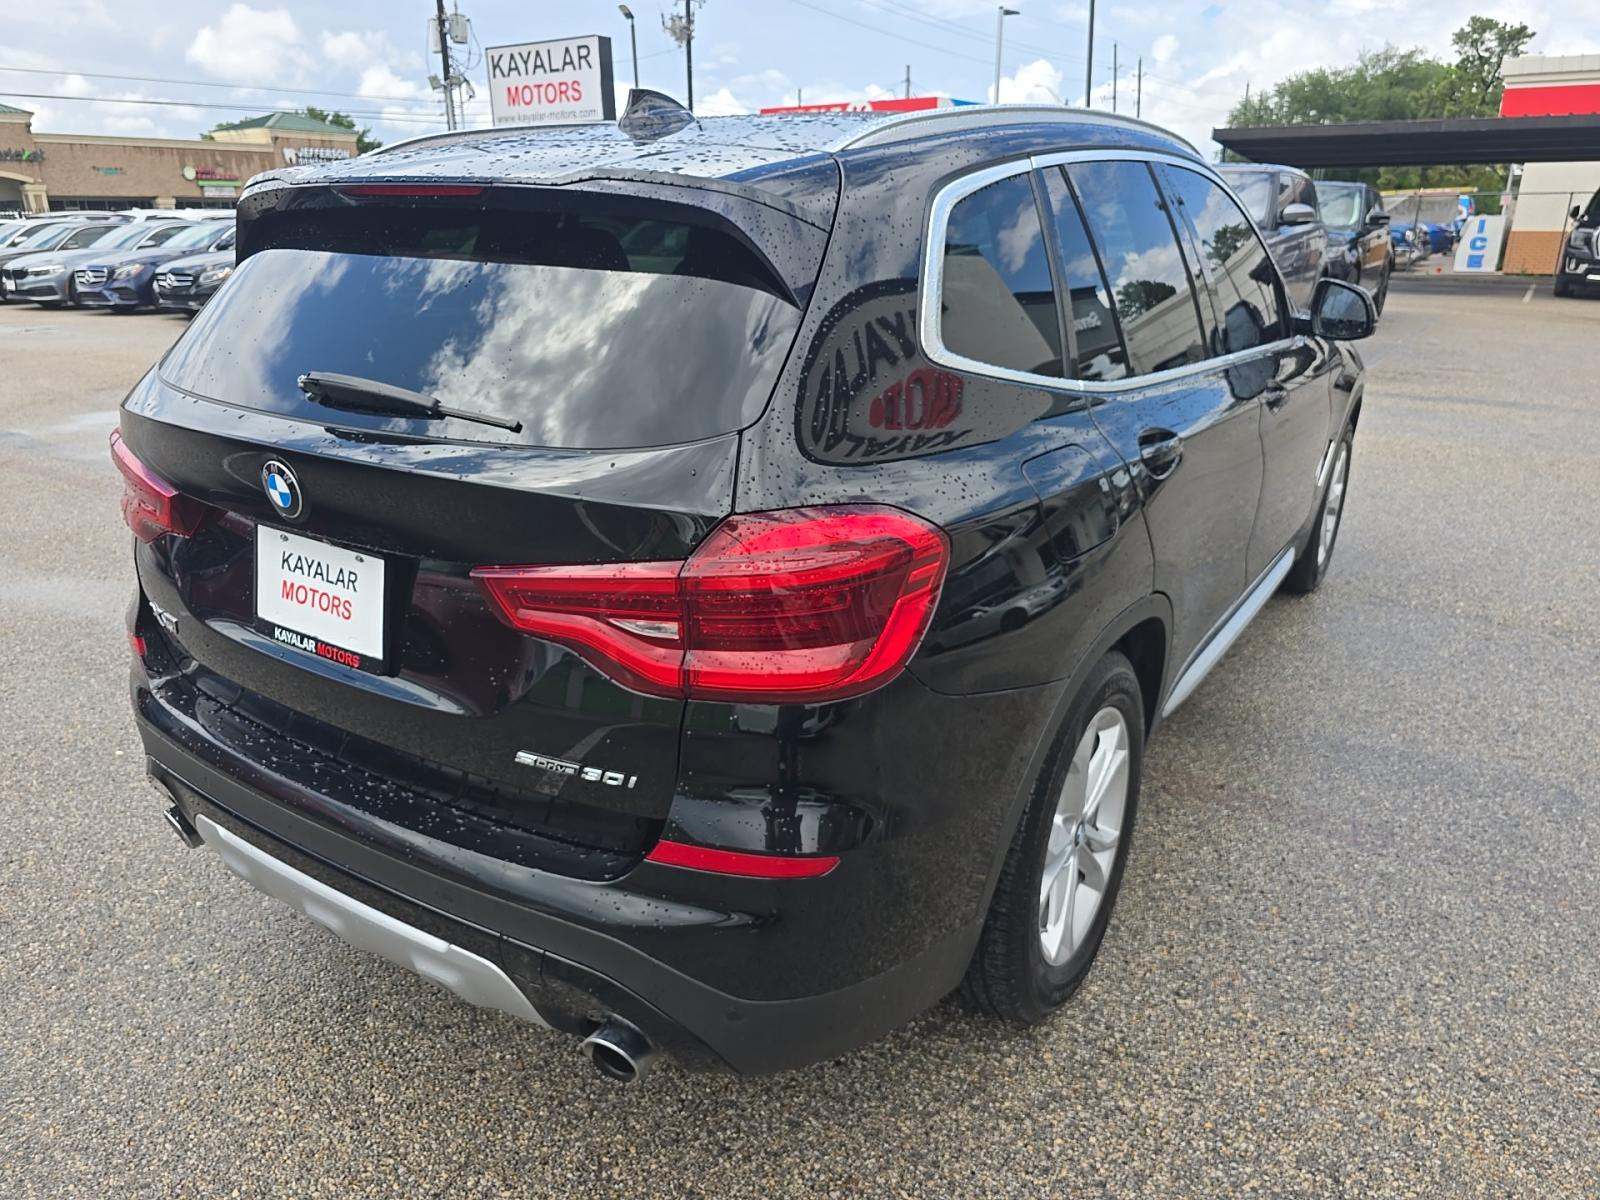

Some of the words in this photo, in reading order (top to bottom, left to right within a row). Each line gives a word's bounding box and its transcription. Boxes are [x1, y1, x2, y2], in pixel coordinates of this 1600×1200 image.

[490, 44, 593, 79] KAYALAR
[506, 80, 583, 107] MOTORS
[280, 550, 359, 593] KAYALAR
[280, 579, 353, 621] MOTORS
[274, 626, 317, 654] KAYALAR
[316, 642, 361, 669] MOTORS
